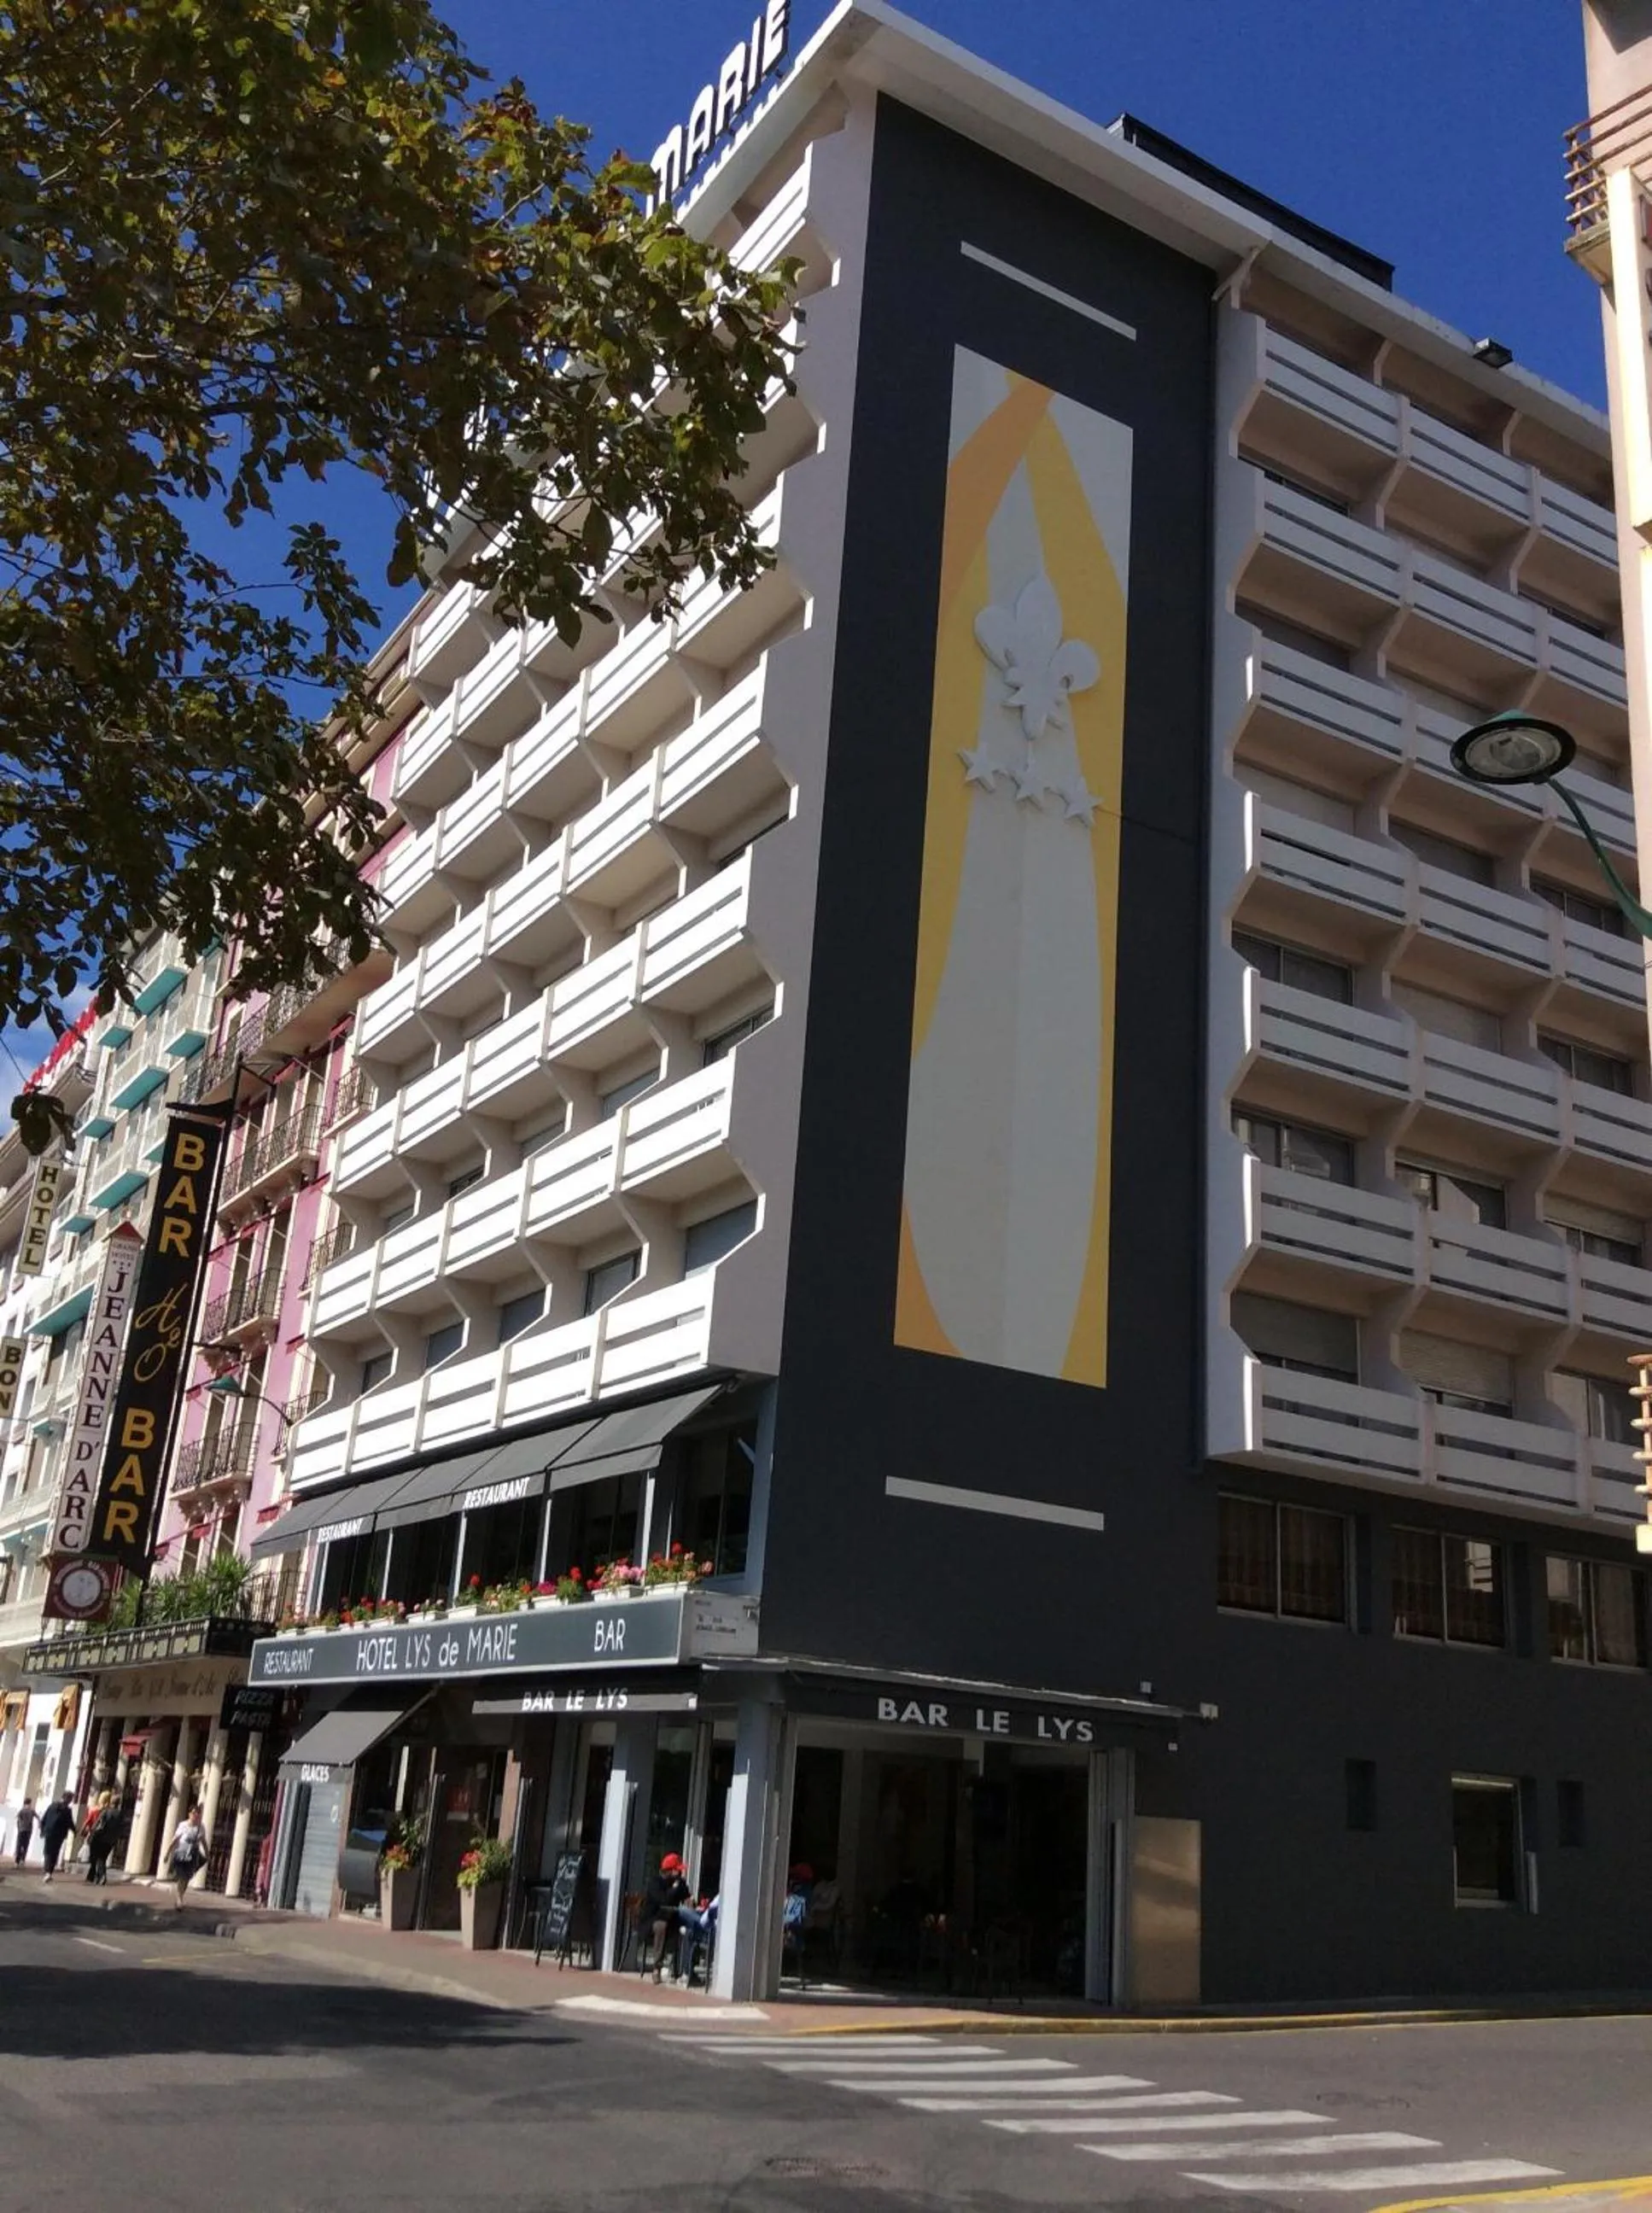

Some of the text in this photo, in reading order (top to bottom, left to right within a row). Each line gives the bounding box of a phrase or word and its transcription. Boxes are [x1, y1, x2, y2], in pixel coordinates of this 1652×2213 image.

[646, 0, 786, 219] MARIE
[24, 1165, 59, 1267] HOTEL
[159, 1132, 206, 1258] BAR
[84, 1270, 129, 1429] JEANNE
[59, 1440, 101, 1549] D'ARC
[102, 1407, 155, 1544] BAR
[462, 1477, 530, 1510] RESTAURANT
[317, 1517, 364, 1544] RESTAURANT
[263, 1618, 627, 1675] RESTAURANT HOTEL LYS de MARIE BAR
[521, 1687, 629, 1712] BAR LE LYS
[877, 1696, 1095, 1743] BAR LE LYS
[301, 1764, 330, 1783] GLACES
